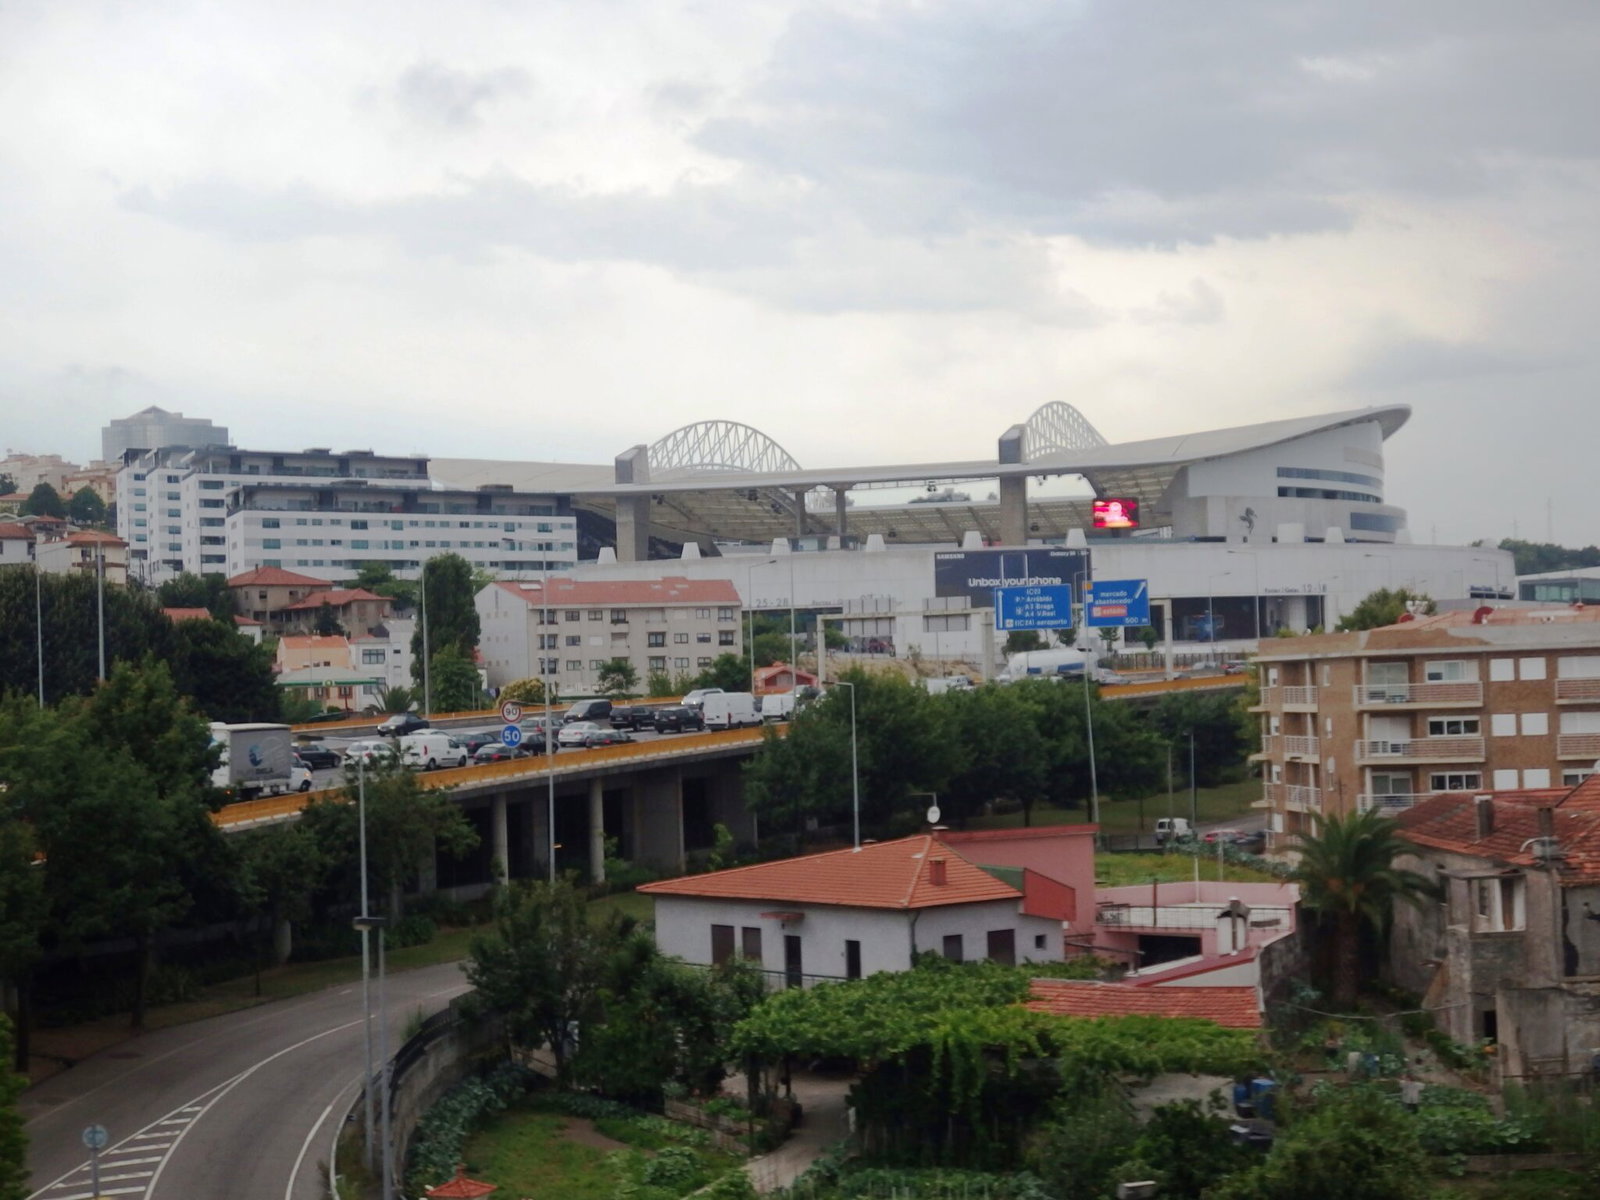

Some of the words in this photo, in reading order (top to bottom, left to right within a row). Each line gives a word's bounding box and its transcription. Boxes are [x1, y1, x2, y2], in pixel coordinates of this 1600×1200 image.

[968, 578, 1001, 587] Unbox
[1003, 579, 1027, 588] your
[1029, 577, 1062, 587] phone
[505, 708, 517, 716] 90
[504, 730, 520, 742] 50
